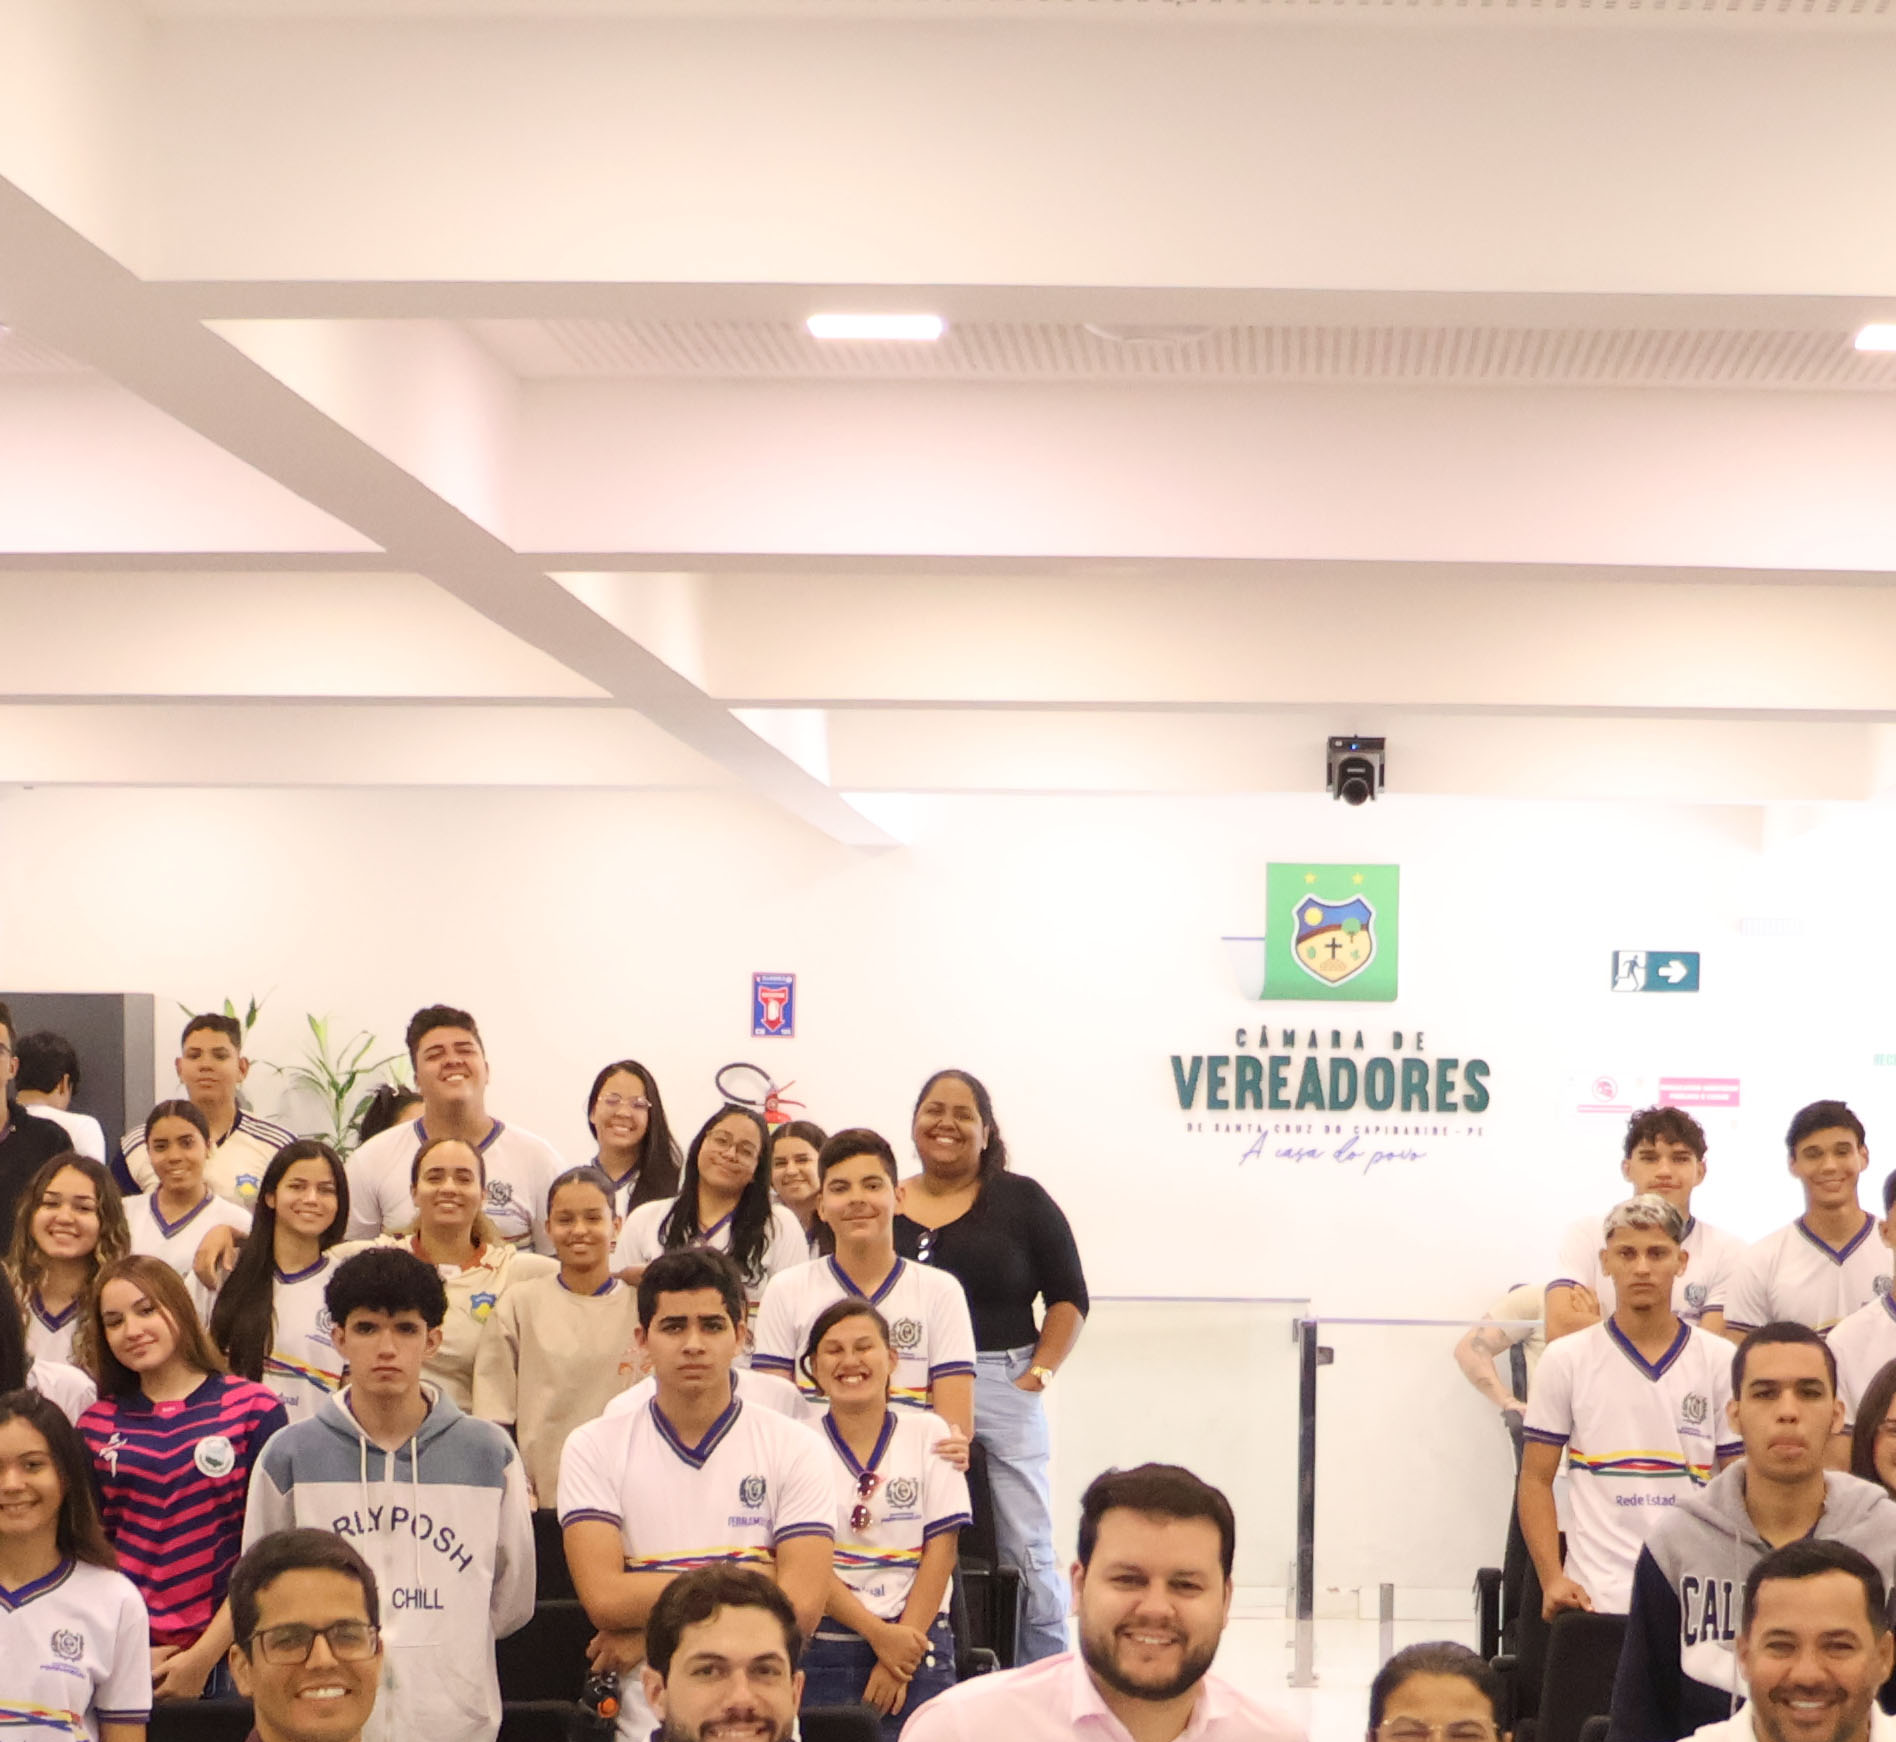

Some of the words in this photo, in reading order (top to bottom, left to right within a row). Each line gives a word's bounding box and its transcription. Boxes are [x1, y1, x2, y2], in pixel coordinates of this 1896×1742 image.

[1235, 1024, 1364, 1050] CÂMARA
[1393, 1030, 1424, 1051] DE
[1170, 1055, 1491, 1112] VEREADORES
[1616, 1494, 1644, 1506] Rede
[333, 1505, 473, 1573] RLYPOSH
[392, 1588, 444, 1610] CHILL
[1681, 1575, 1749, 1648] CAL
